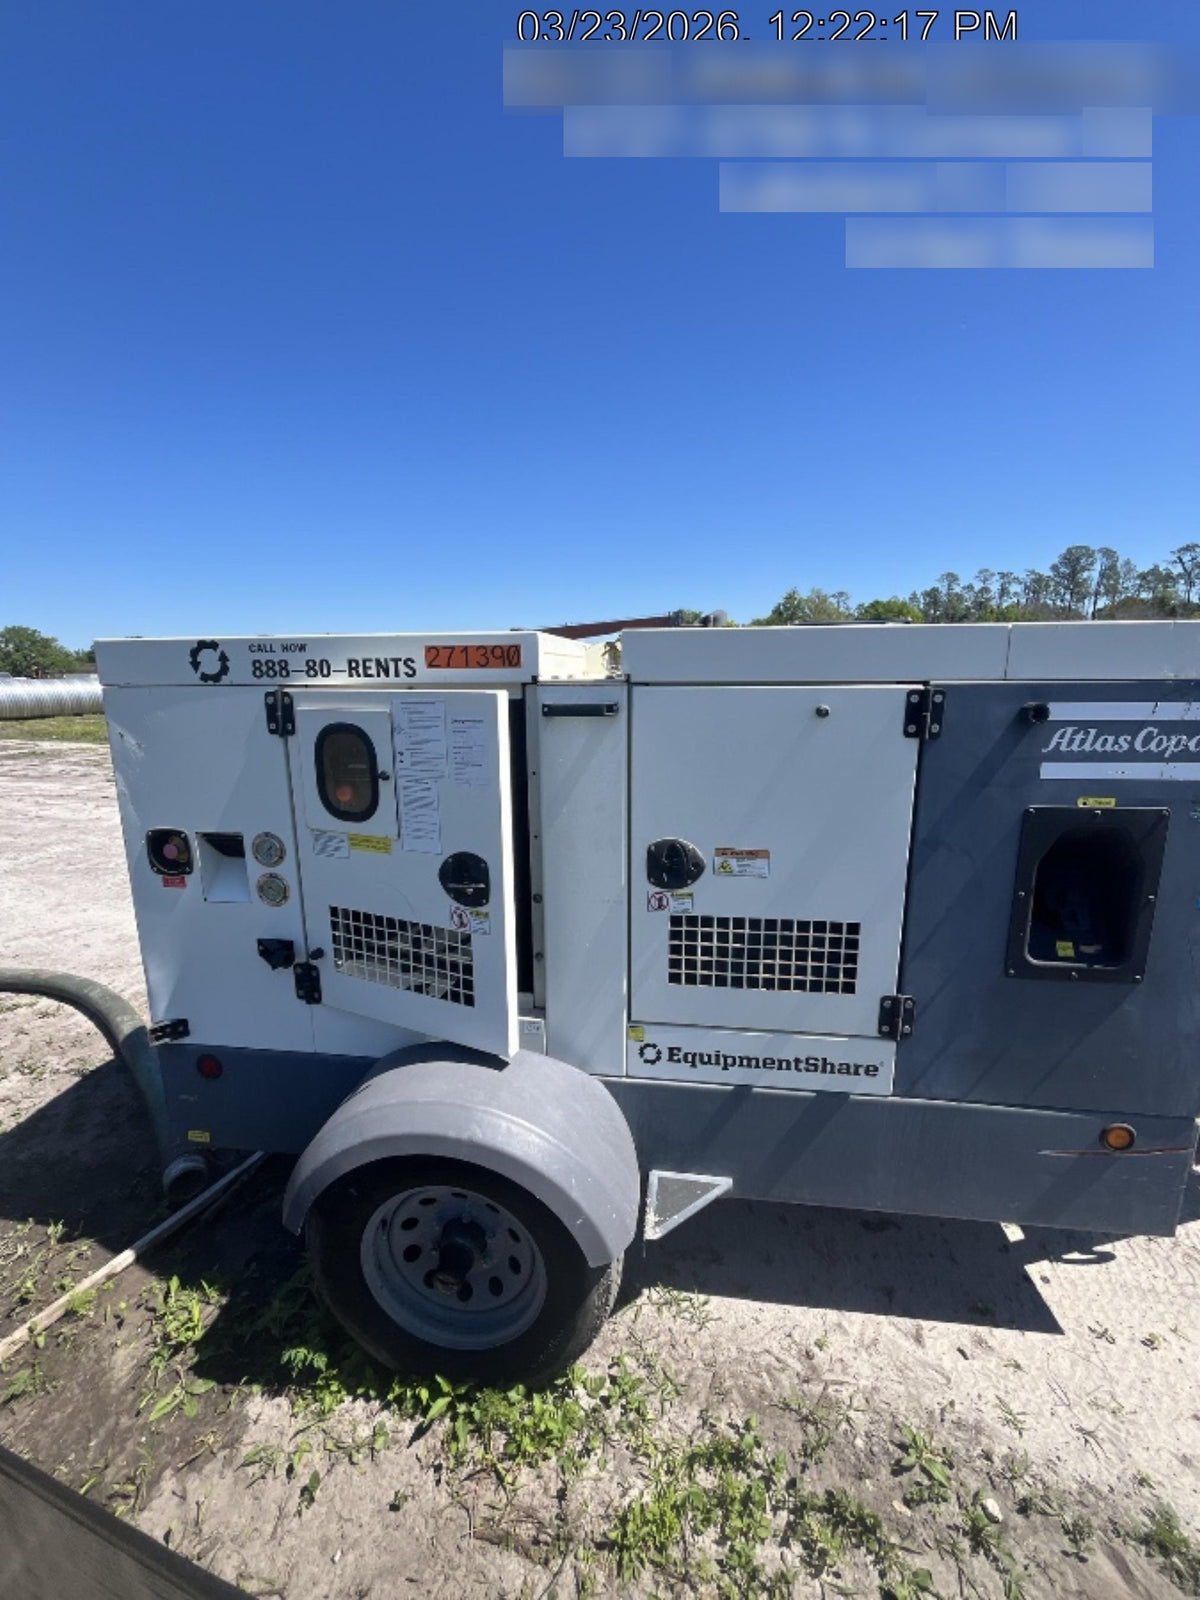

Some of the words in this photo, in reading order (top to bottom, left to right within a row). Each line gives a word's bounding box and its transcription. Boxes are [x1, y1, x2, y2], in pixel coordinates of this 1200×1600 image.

[248, 642, 277, 654] CALL
[280, 642, 308, 654] NOW
[427, 644, 521, 668] 271390
[251, 657, 417, 679] 888-80-RENTS
[1041, 726, 1132, 753] Atlas
[667, 1046, 880, 1077] EquipmentShare
